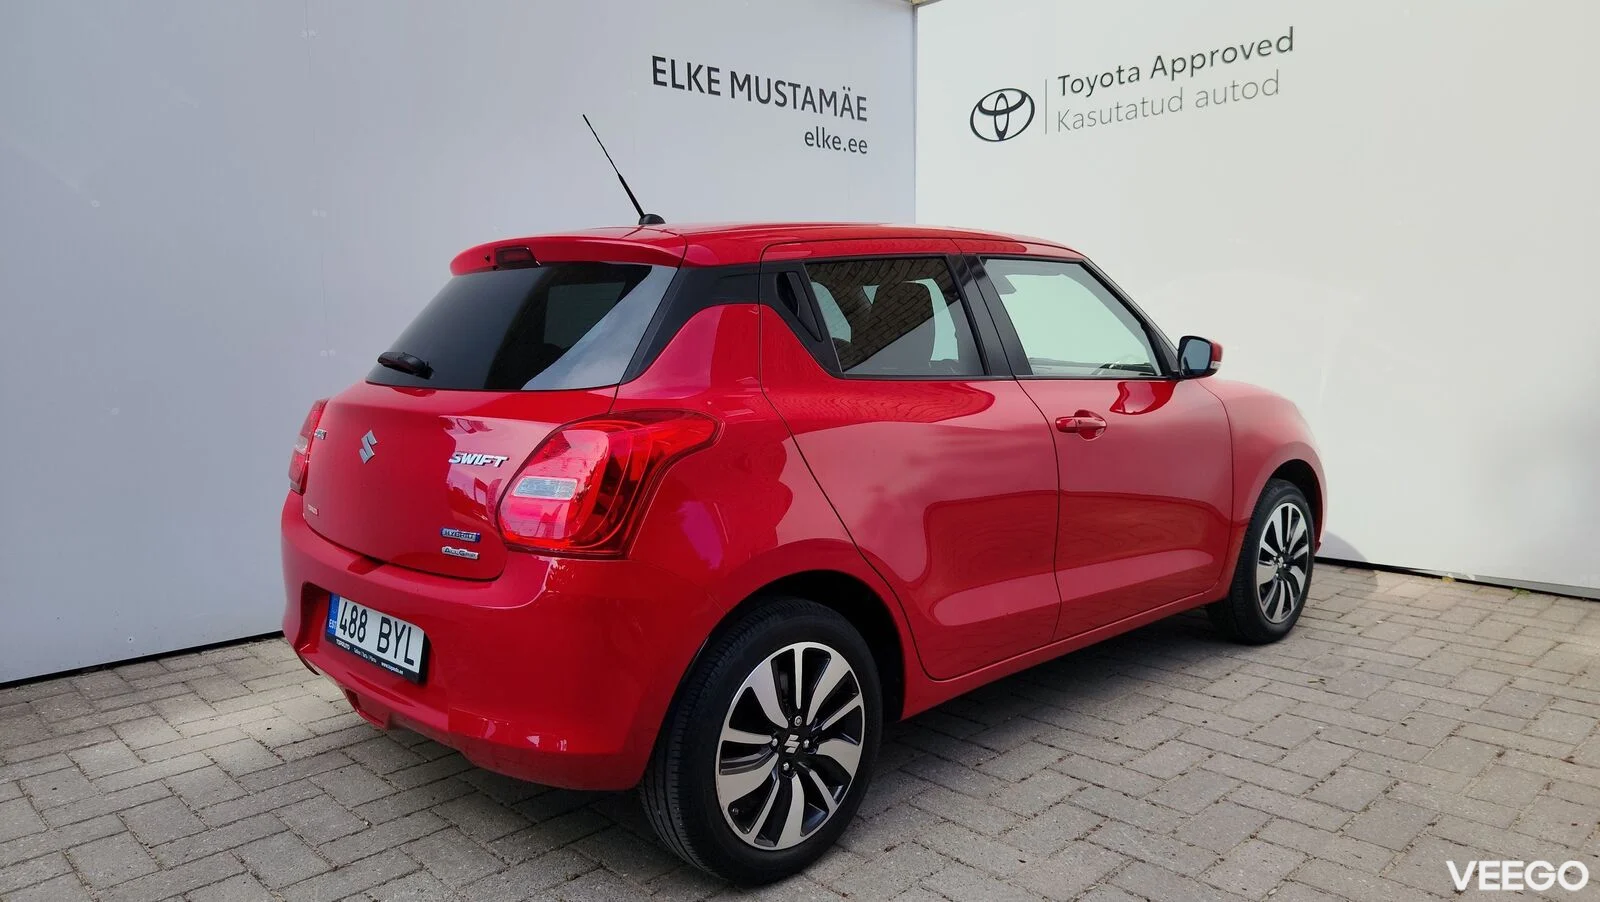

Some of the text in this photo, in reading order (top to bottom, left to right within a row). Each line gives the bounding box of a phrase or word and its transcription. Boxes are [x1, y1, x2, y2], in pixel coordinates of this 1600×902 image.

[652, 55, 868, 122] ELKE MUSTAMÄE
[1057, 26, 1294, 98] Toyota Approved
[1057, 69, 1280, 132] Kasutatud autod
[804, 126, 868, 154] elke.ee
[448, 451, 509, 467] SWIFT
[339, 601, 415, 666] 488 BYL
